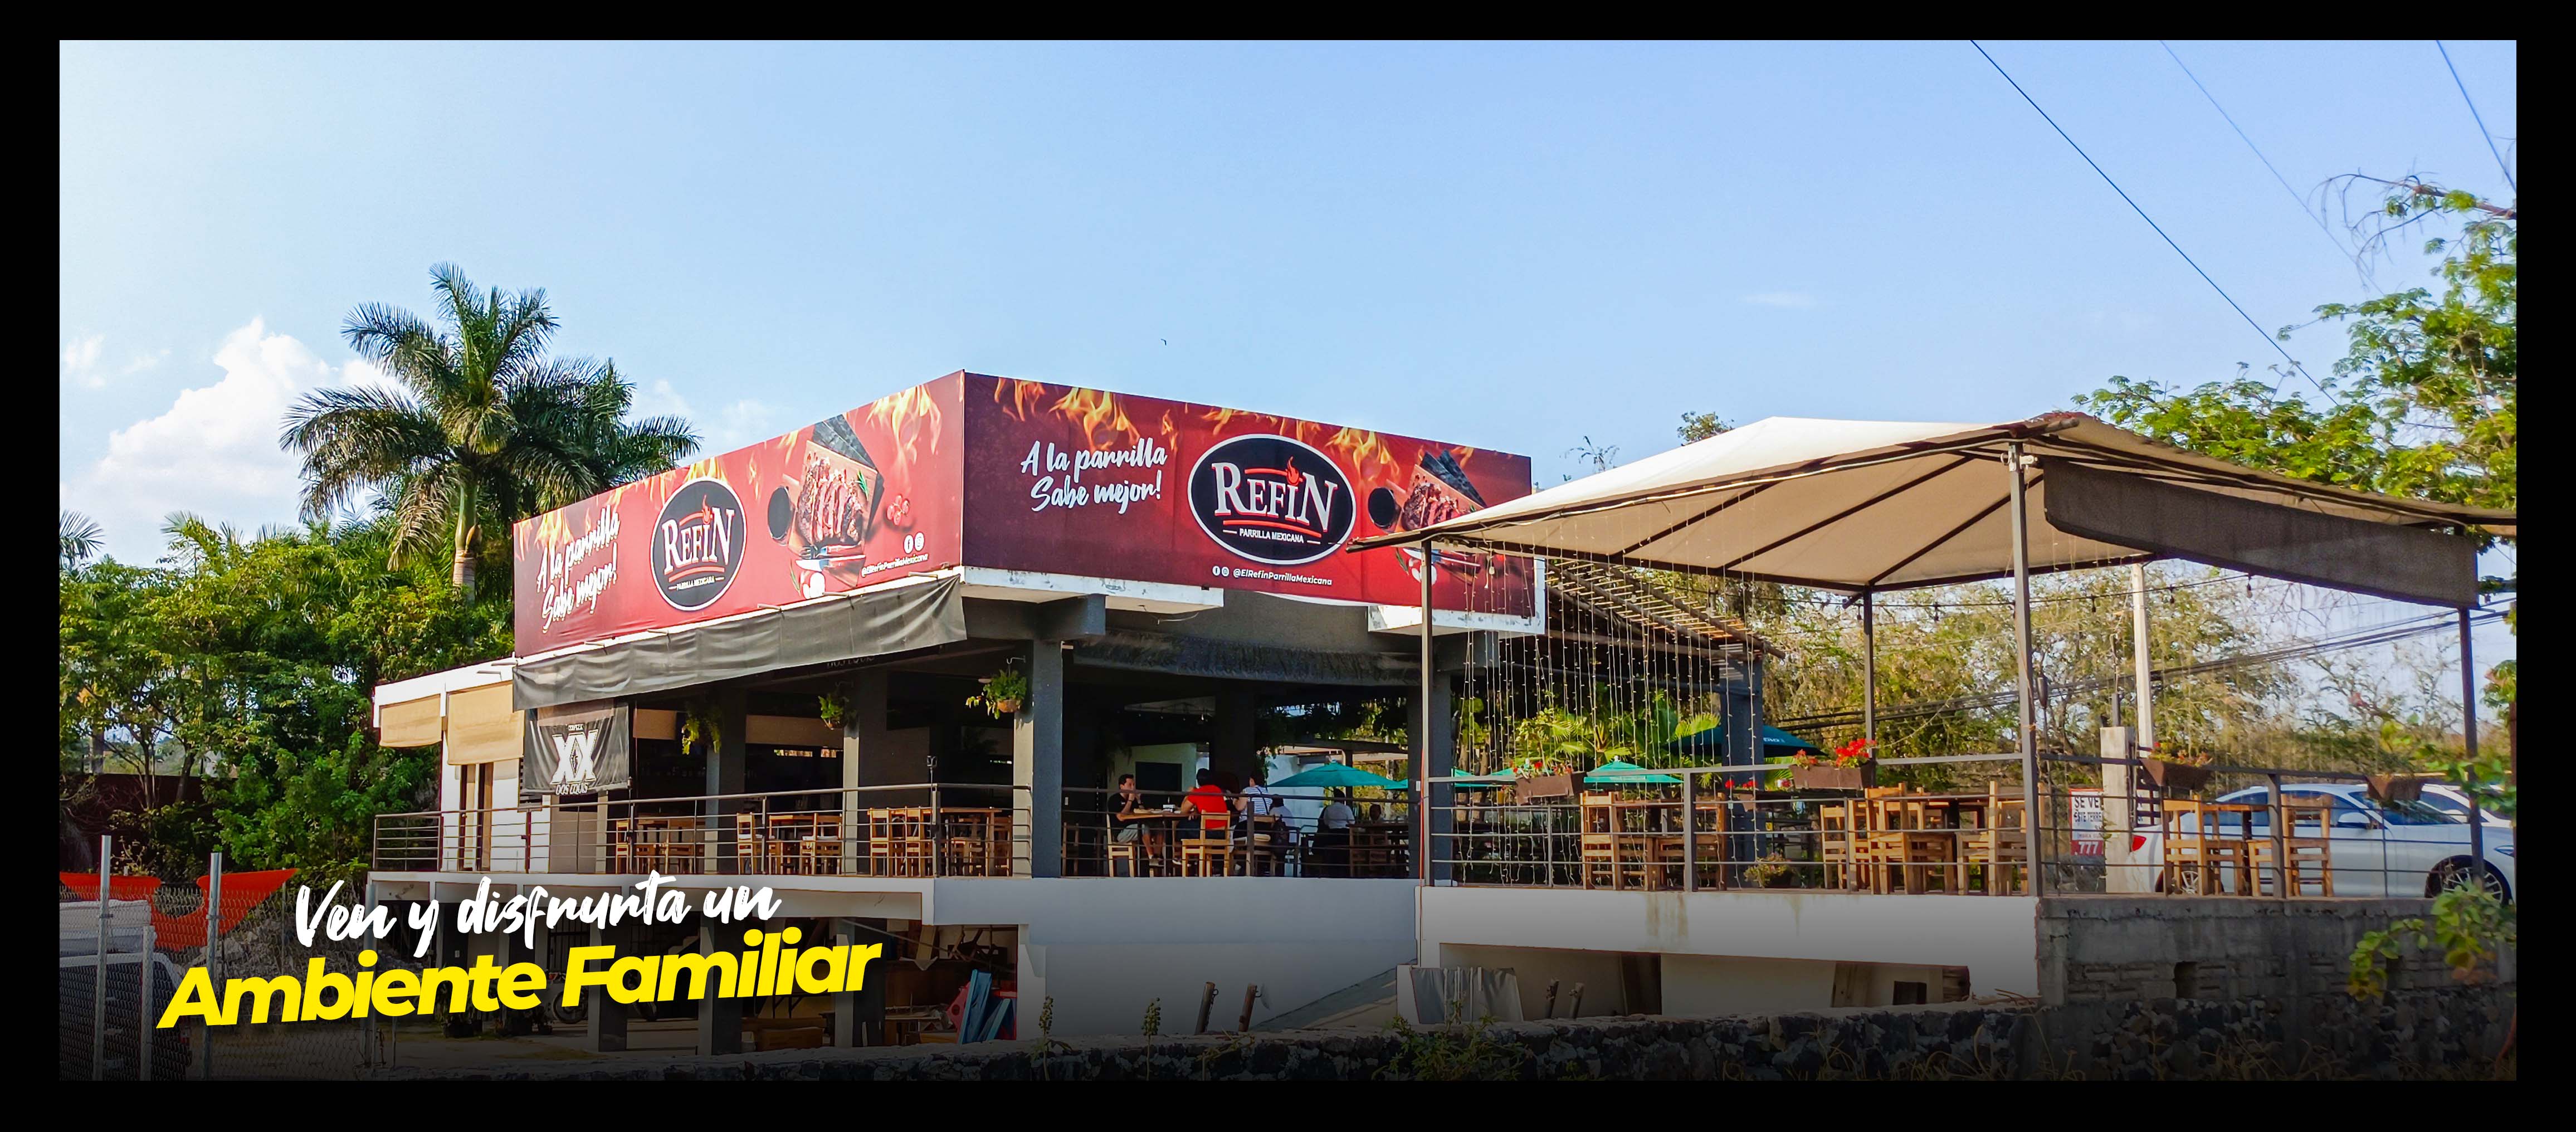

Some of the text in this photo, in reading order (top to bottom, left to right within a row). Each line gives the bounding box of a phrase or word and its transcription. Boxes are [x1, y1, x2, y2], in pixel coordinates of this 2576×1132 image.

[1021, 437, 1168, 483] A la parrilla
[1031, 470, 1162, 514] Sabe mejor!
[536, 505, 621, 593] A la parrilla
[1240, 528, 1304, 543] PARRILLA MEXICANA
[542, 541, 617, 633] Sabe mejor!
[549, 729, 598, 784] XX
[2074, 797, 2102, 808] SE VE
[2087, 812, 2102, 822] TERRE
